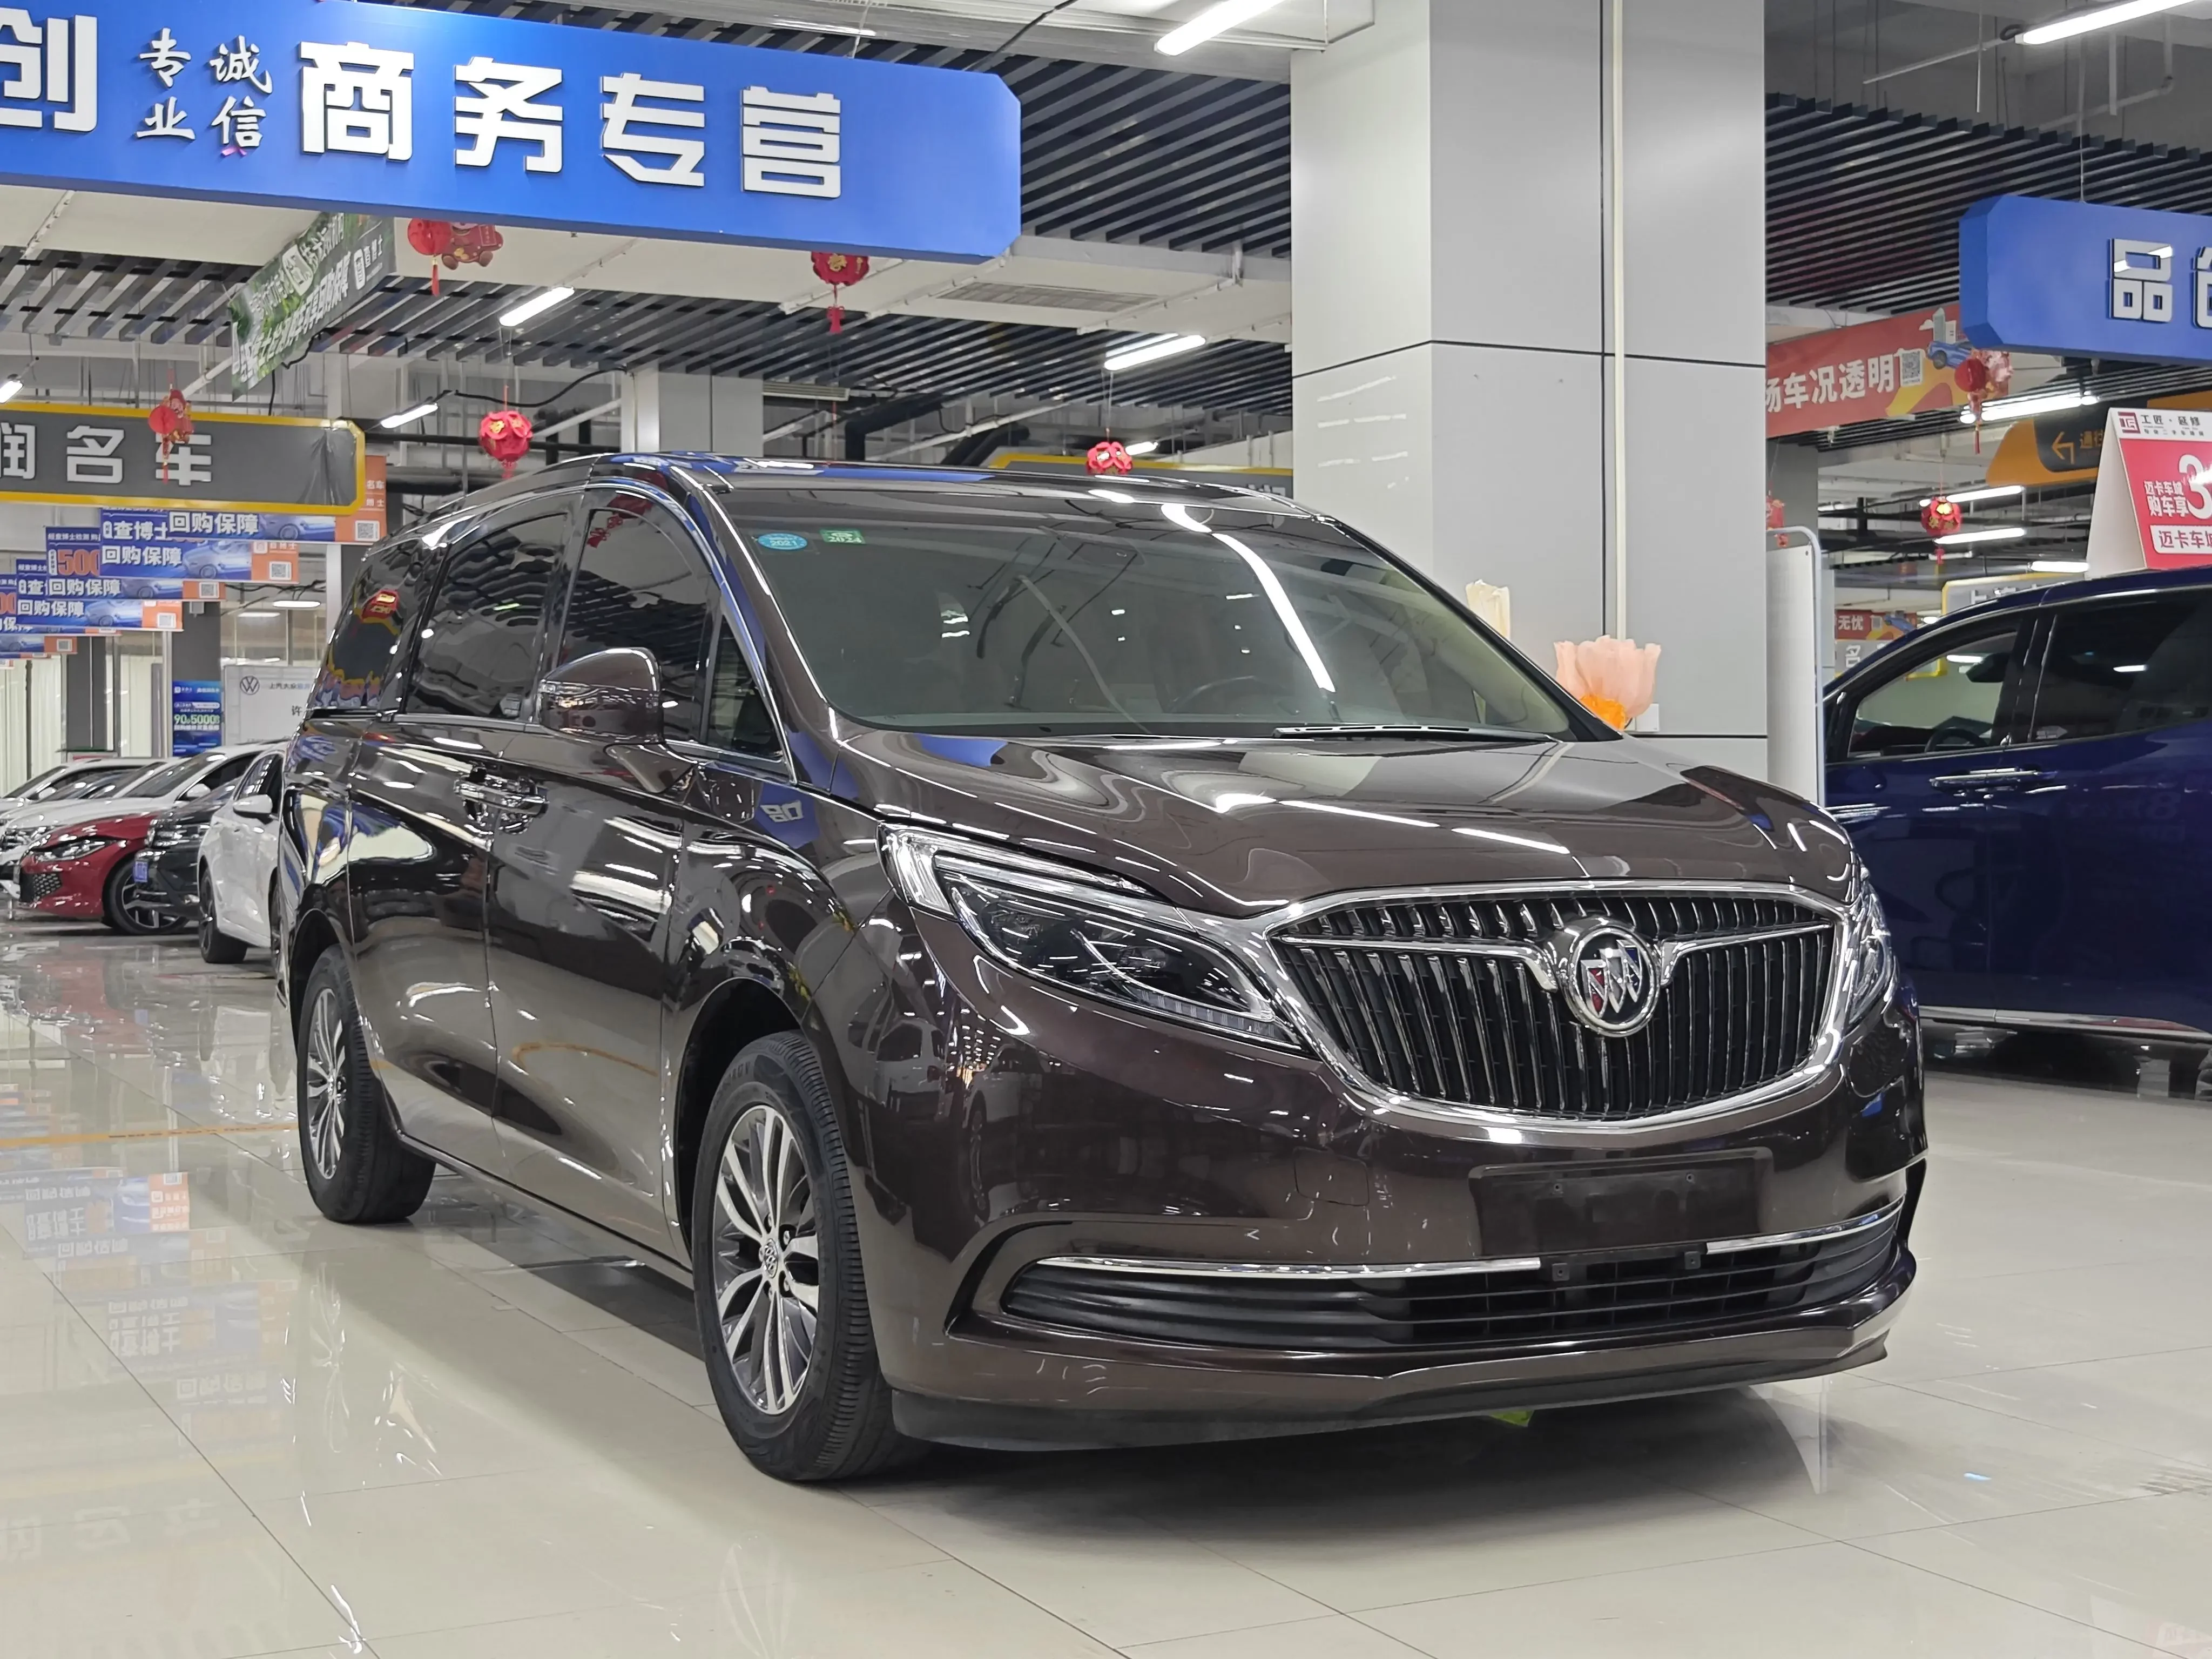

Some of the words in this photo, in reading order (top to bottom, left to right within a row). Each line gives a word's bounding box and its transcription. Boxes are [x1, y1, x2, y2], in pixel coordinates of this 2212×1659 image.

[299, 42, 841, 199] 商务专营
[169, 512, 258, 535] 回购保障
[102, 545, 181, 566] 回购保障
[49, 578, 120, 596] 回购保障
[17, 599, 84, 617] 回购保障
